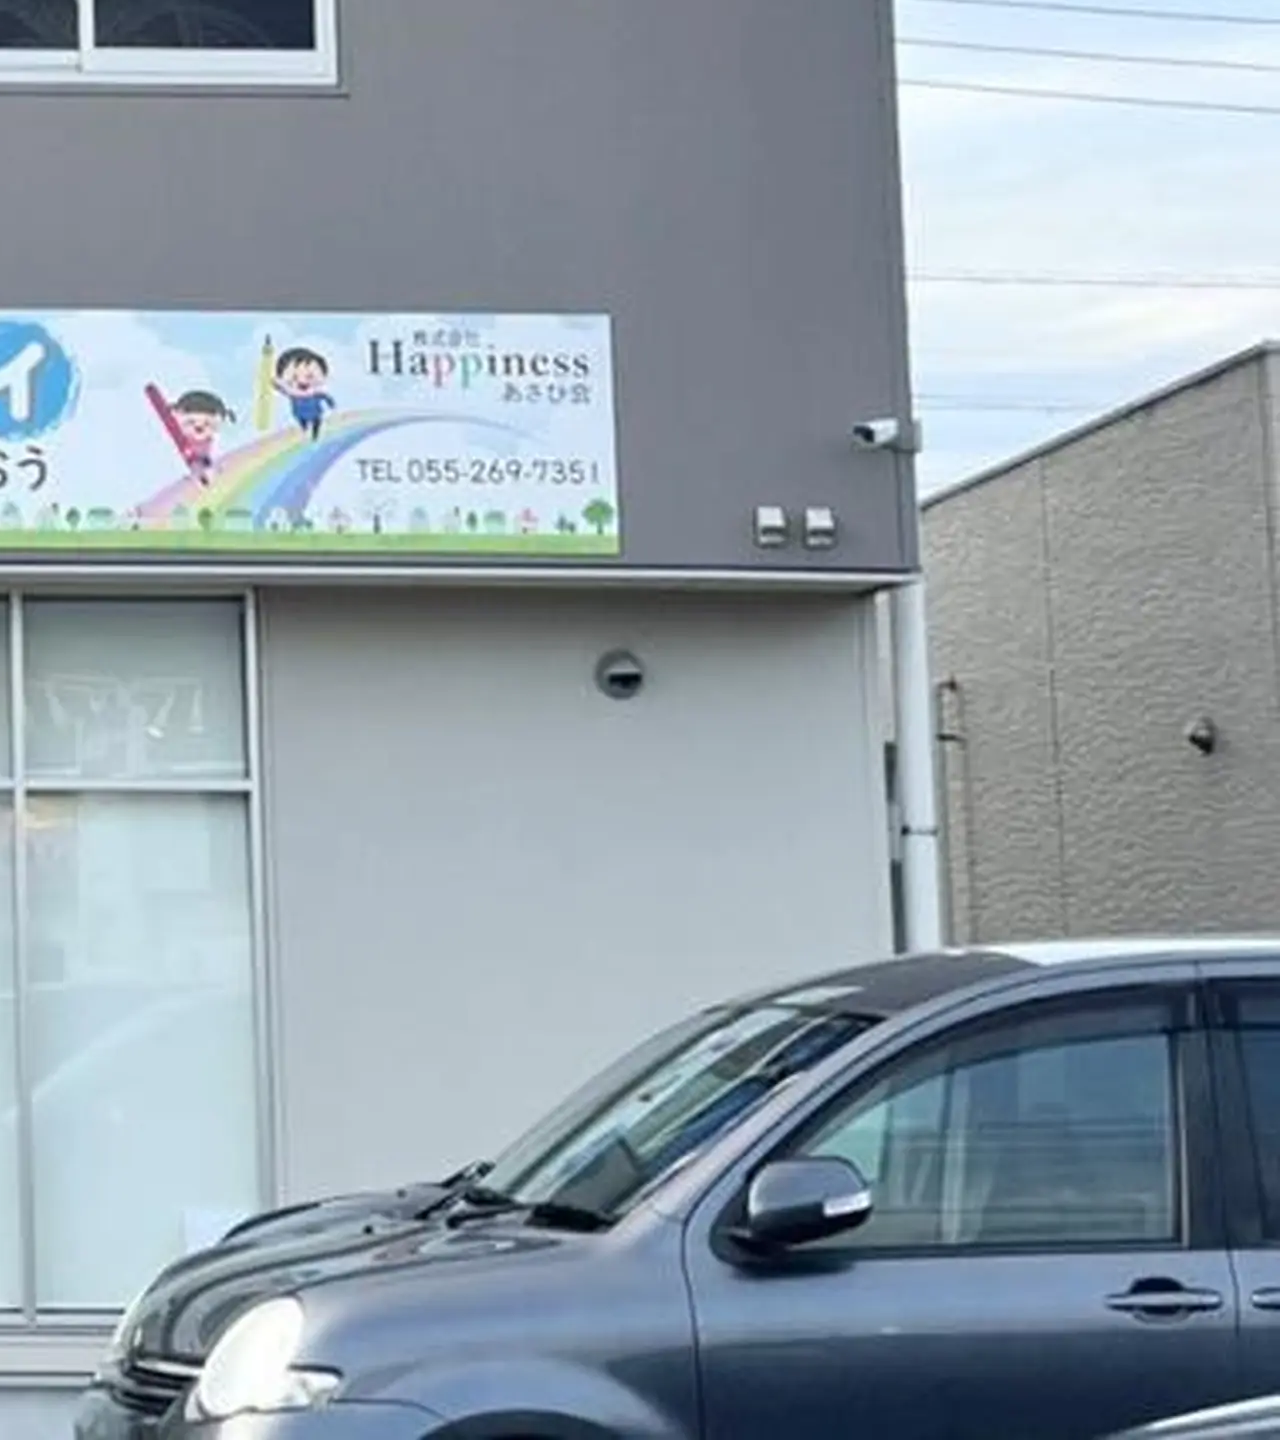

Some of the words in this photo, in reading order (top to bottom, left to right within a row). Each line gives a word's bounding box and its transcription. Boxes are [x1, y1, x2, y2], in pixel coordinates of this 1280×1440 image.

[368, 340, 590, 389] Happiness
[356, 459, 402, 483] TEL
[407, 459, 600, 485] 055-269-7351
